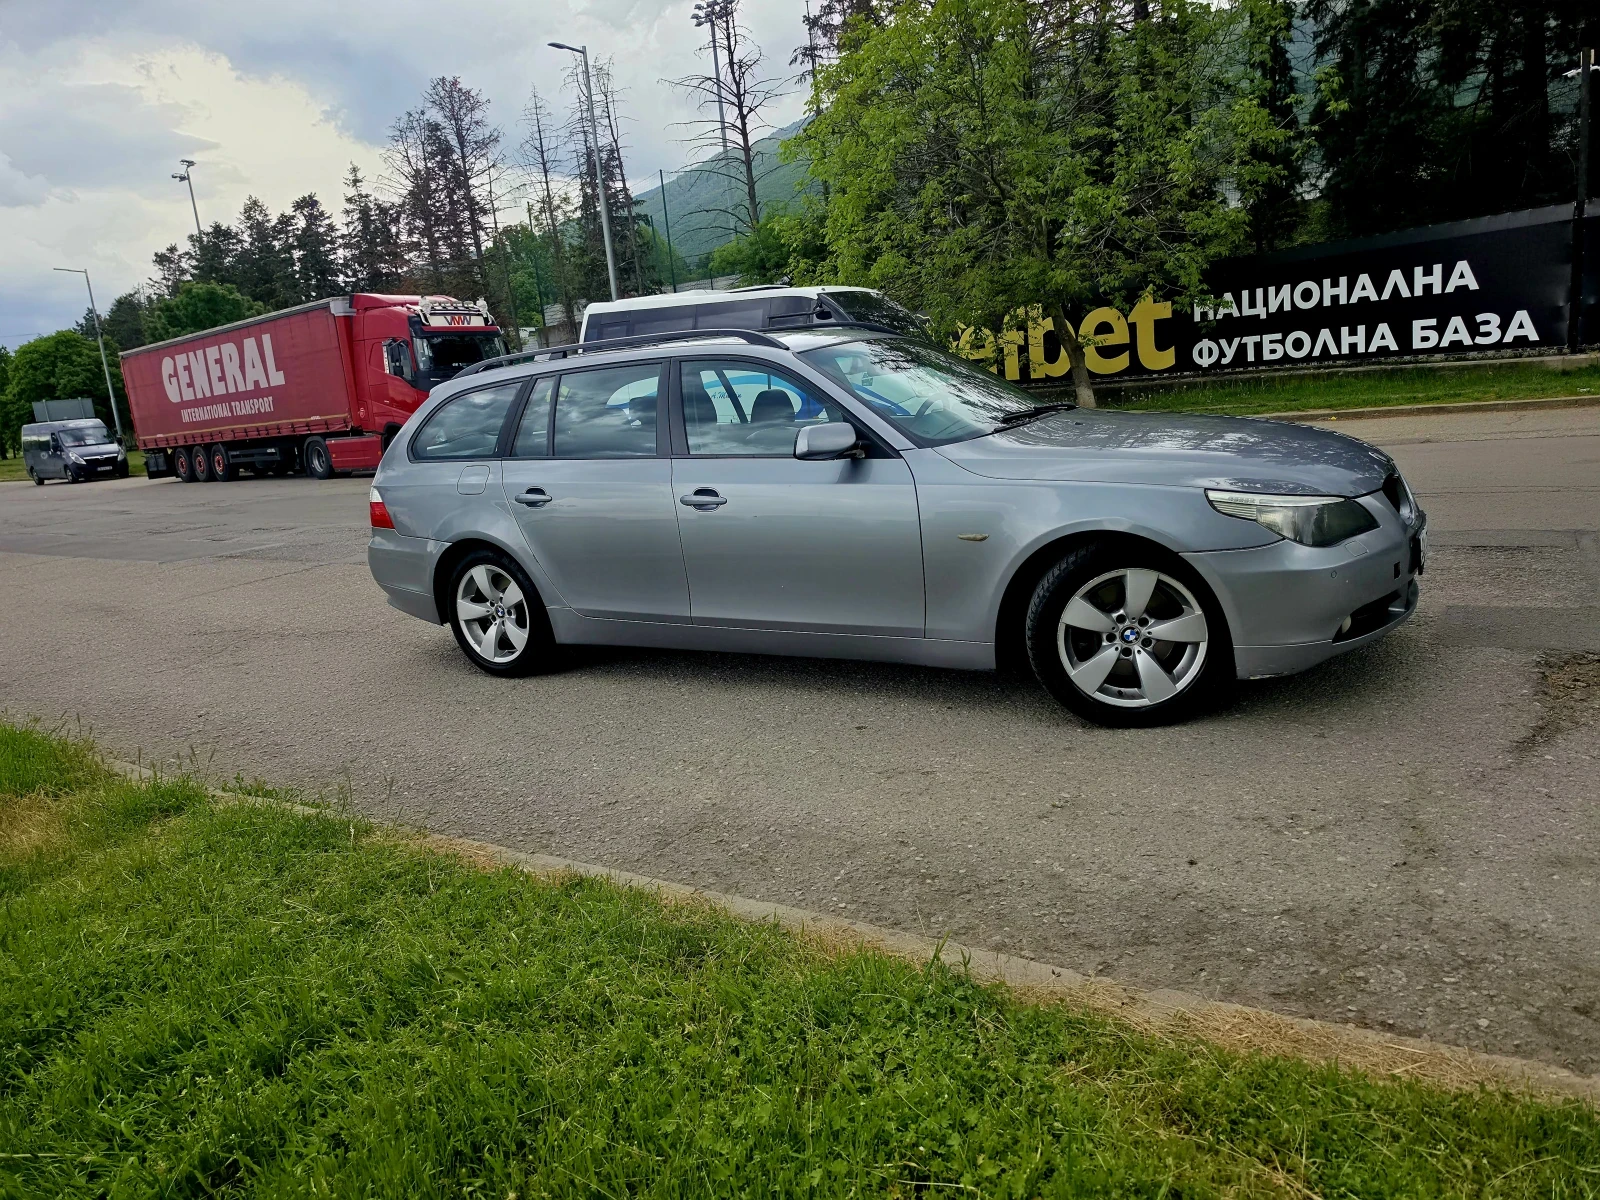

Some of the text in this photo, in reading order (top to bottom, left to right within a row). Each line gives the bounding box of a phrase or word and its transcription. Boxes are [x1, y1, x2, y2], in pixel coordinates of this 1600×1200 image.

[1193, 259, 1480, 323] НАЦИОНАЛНА
[161, 333, 286, 404] GENERAL
[1192, 309, 1540, 368] ФУТБОЛНА БАЗА
[180, 396, 274, 423] INTERNATIONAL TRANSPORT
